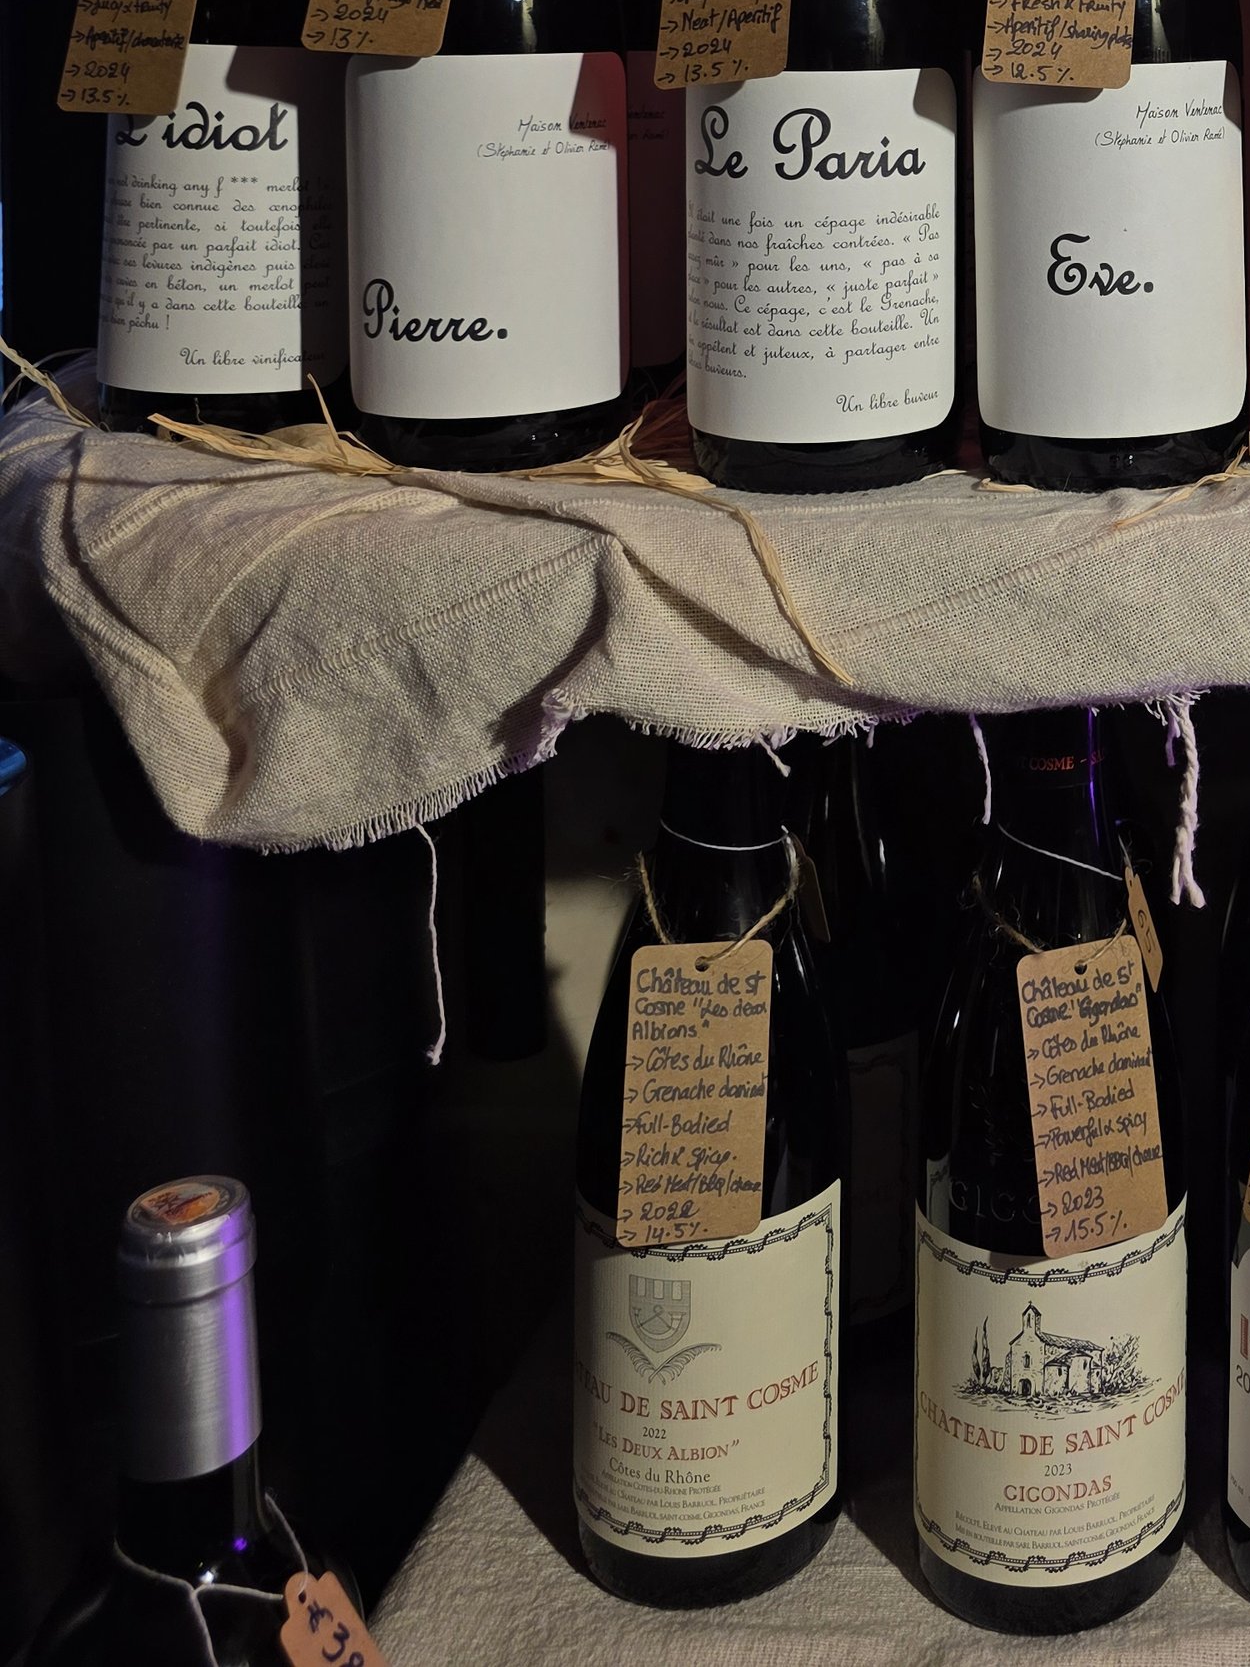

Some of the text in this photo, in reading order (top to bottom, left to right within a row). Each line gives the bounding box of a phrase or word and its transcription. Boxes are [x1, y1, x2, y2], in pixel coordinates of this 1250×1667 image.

[334, 5, 388, 22] 2024
[682, 38, 732, 58] 2024
[1006, 41, 1062, 59] 2024
[85, 62, 130, 80] 2024
[1136, 101, 1222, 128] Maison Ventenac
[542, 141, 551, 155] et
[555, 140, 584, 155] Olivier
[695, 106, 748, 178] Le
[773, 107, 926, 181] Paria
[1158, 130, 1167, 145] et
[1172, 128, 1199, 143] Olivier
[138, 217, 300, 237] pertinente, si toutefois
[1047, 233, 1154, 296] Eve.
[167, 277, 294, 292] béton, un merlot
[363, 278, 508, 342] Pierre.
[180, 348, 245, 365] Un libre
[836, 389, 939, 413] Un libre buveur
[1029, 756, 1075, 770] COSME
[1093, 972, 1115, 989] de
[693, 1045, 715, 1070] du
[718, 1043, 765, 1067] Rhône
[643, 1079, 714, 1104] Grenache
[1062, 1185, 1105, 1215] 2023
[620, 1361, 819, 1422] DE SAINT COSME
[642, 1426, 667, 1440] 2022
[920, 1391, 1008, 1452] CHATEAU
[1020, 1435, 1054, 1456] DE
[1065, 1416, 1136, 1453] SAINT
[622, 1436, 662, 1461] DEUX
[609, 1457, 711, 1483] Côtes du Rhône
[1044, 1464, 1072, 1477] 2023
[1003, 1475, 1113, 1502] GIGONDAS
